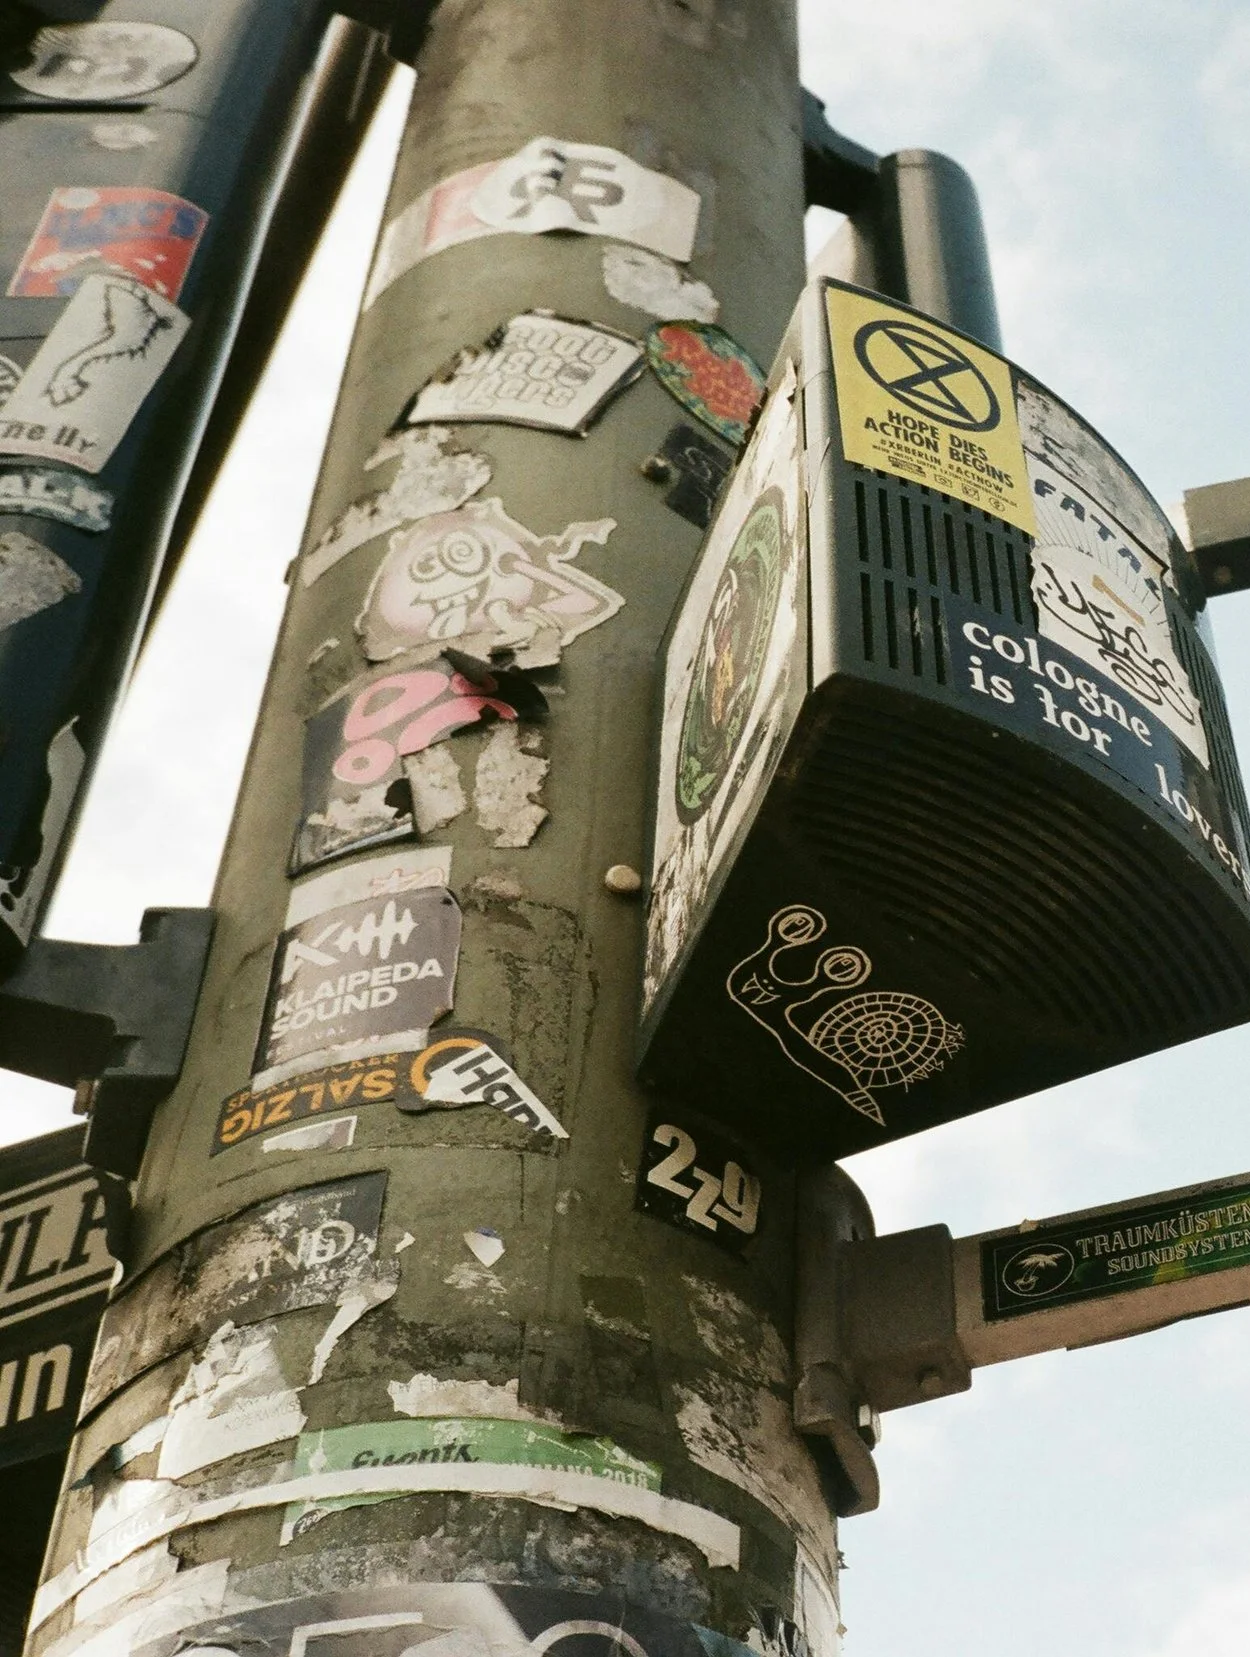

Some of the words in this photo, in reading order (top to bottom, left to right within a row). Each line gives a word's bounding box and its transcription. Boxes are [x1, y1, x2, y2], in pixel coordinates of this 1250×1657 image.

[864, 417, 940, 453] ACTION
[949, 447, 1014, 489] BEGINS
[880, 438, 941, 466] #XRBERLIN
[948, 464, 1003, 493] #ACTNOW
[887, 409, 940, 441] HOPE
[949, 434, 988, 462] DIES
[961, 621, 1153, 746] cologne
[967, 656, 1015, 704] is
[1033, 683, 1113, 757] for
[270, 986, 398, 1041] SOUND
[274, 957, 445, 1020] KLAIPEDA
[219, 1068, 398, 1144] SALZIG
